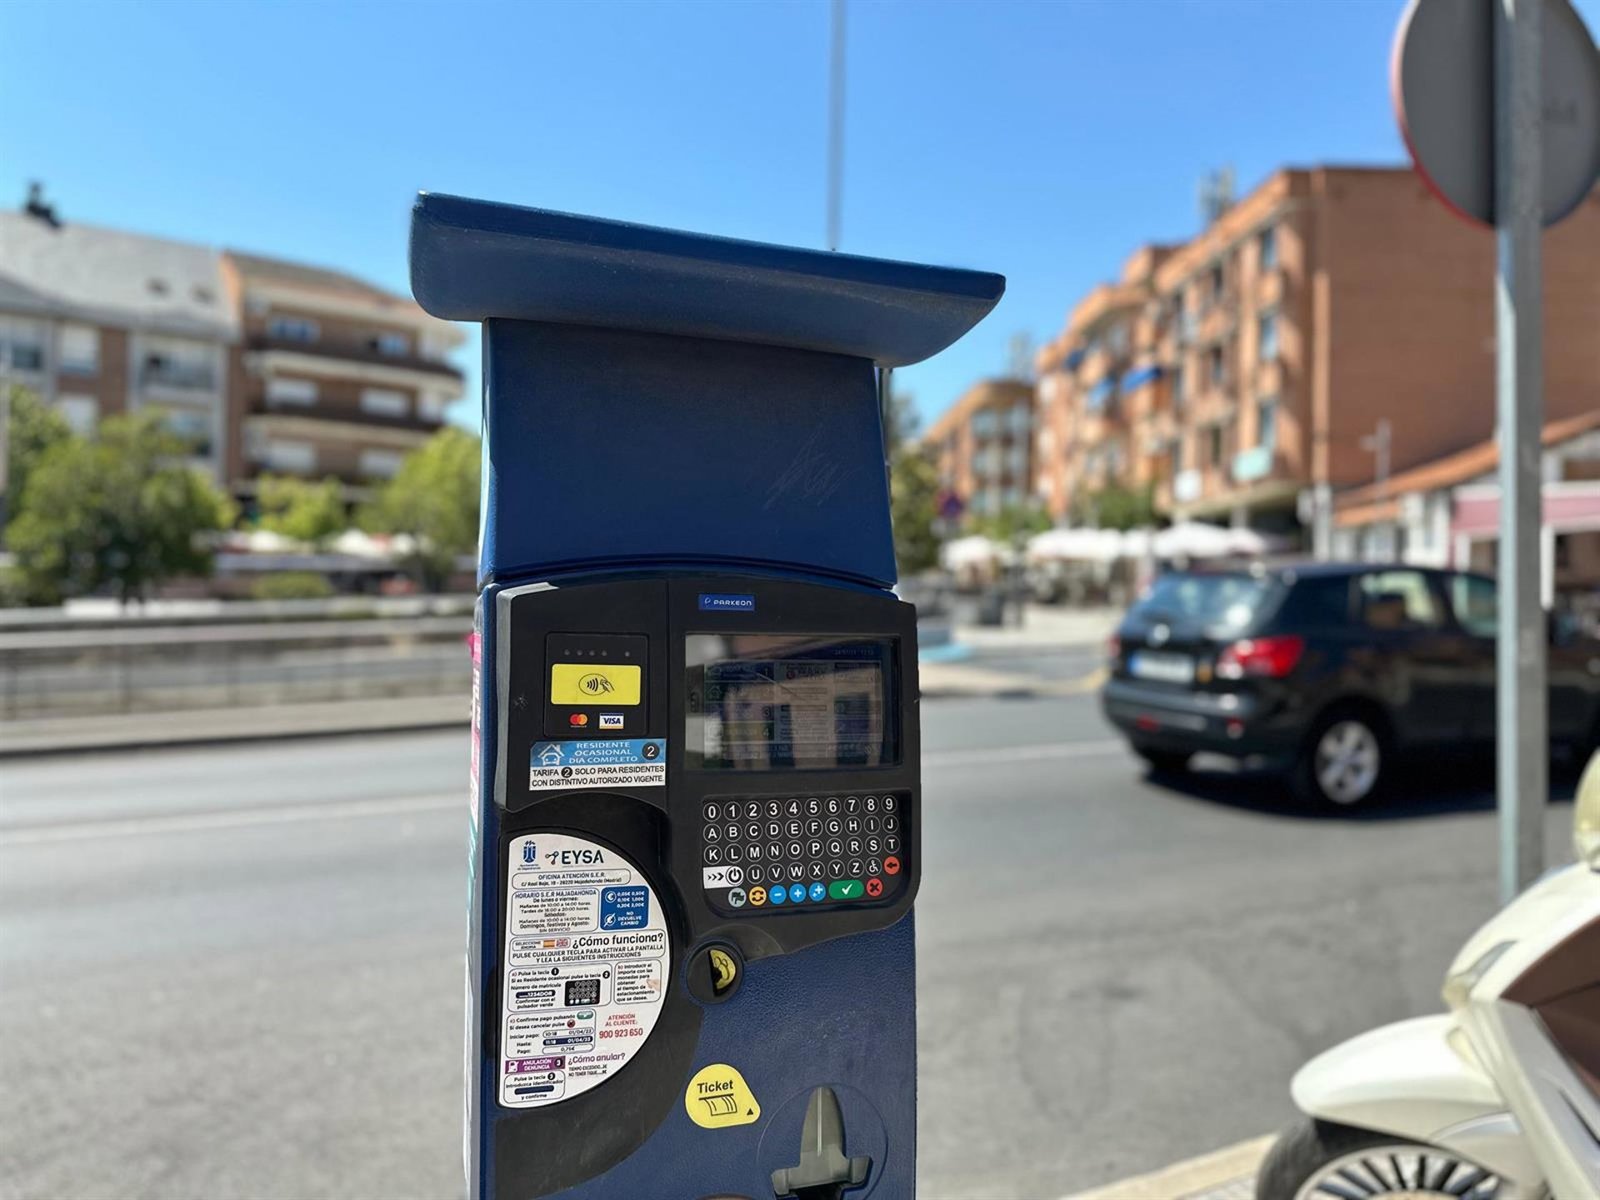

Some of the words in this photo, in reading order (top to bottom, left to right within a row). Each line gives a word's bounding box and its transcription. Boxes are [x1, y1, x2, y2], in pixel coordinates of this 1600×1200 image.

[648, 746, 655, 757] 2
[532, 769, 559, 777] TARIFA
[575, 768, 596, 776] SOLO
[598, 767, 618, 775] PARA
[618, 766, 665, 774] RESIDENTES
[549, 778, 588, 786] DISTINTIVO
[588, 776, 632, 784] AUTORIZADO
[633, 775, 663, 783] VIGENTE
[708, 806, 716, 818] 0
[730, 806, 736, 818] 1
[750, 804, 757, 816] 2
[770, 804, 778, 816] 3
[790, 802, 798, 814] 4
[810, 801, 818, 812] 5
[830, 800, 837, 812] 6
[848, 800, 856, 812] 7
[867, 800, 875, 811] 8
[885, 798, 894, 810] 9
[708, 828, 718, 838] A
[730, 827, 738, 837] B
[750, 826, 758, 836] C
[770, 825, 778, 835] D
[790, 824, 798, 834] E
[811, 822, 818, 832] F
[830, 822, 838, 832] G
[850, 820, 858, 830] H
[870, 820, 874, 830] I
[887, 819, 894, 829] J
[710, 850, 718, 860] K
[730, 848, 738, 858] L
[750, 848, 760, 858] M
[771, 846, 780, 856] N
[791, 844, 800, 855] O
[812, 844, 820, 854] P
[831, 842, 840, 852] Q
[851, 841, 860, 851] R
[870, 840, 878, 850] S
[888, 838, 896, 848] T
[562, 850, 604, 864] EYSA
[752, 870, 760, 880] U
[772, 868, 780, 878] V
[790, 866, 803, 876] W
[813, 866, 821, 876] X
[832, 864, 840, 874] Y
[852, 862, 860, 872] Z
[572, 936, 610, 949] ¿Cómo
[612, 932, 664, 944] funciona?
[599, 1030, 613, 1039] 900
[614, 1029, 628, 1038] 923
[630, 1028, 643, 1036] 650
[568, 1056, 595, 1065] ¿Cómo
[596, 1052, 626, 1062] anular?
[697, 1080, 734, 1094] Ticket
